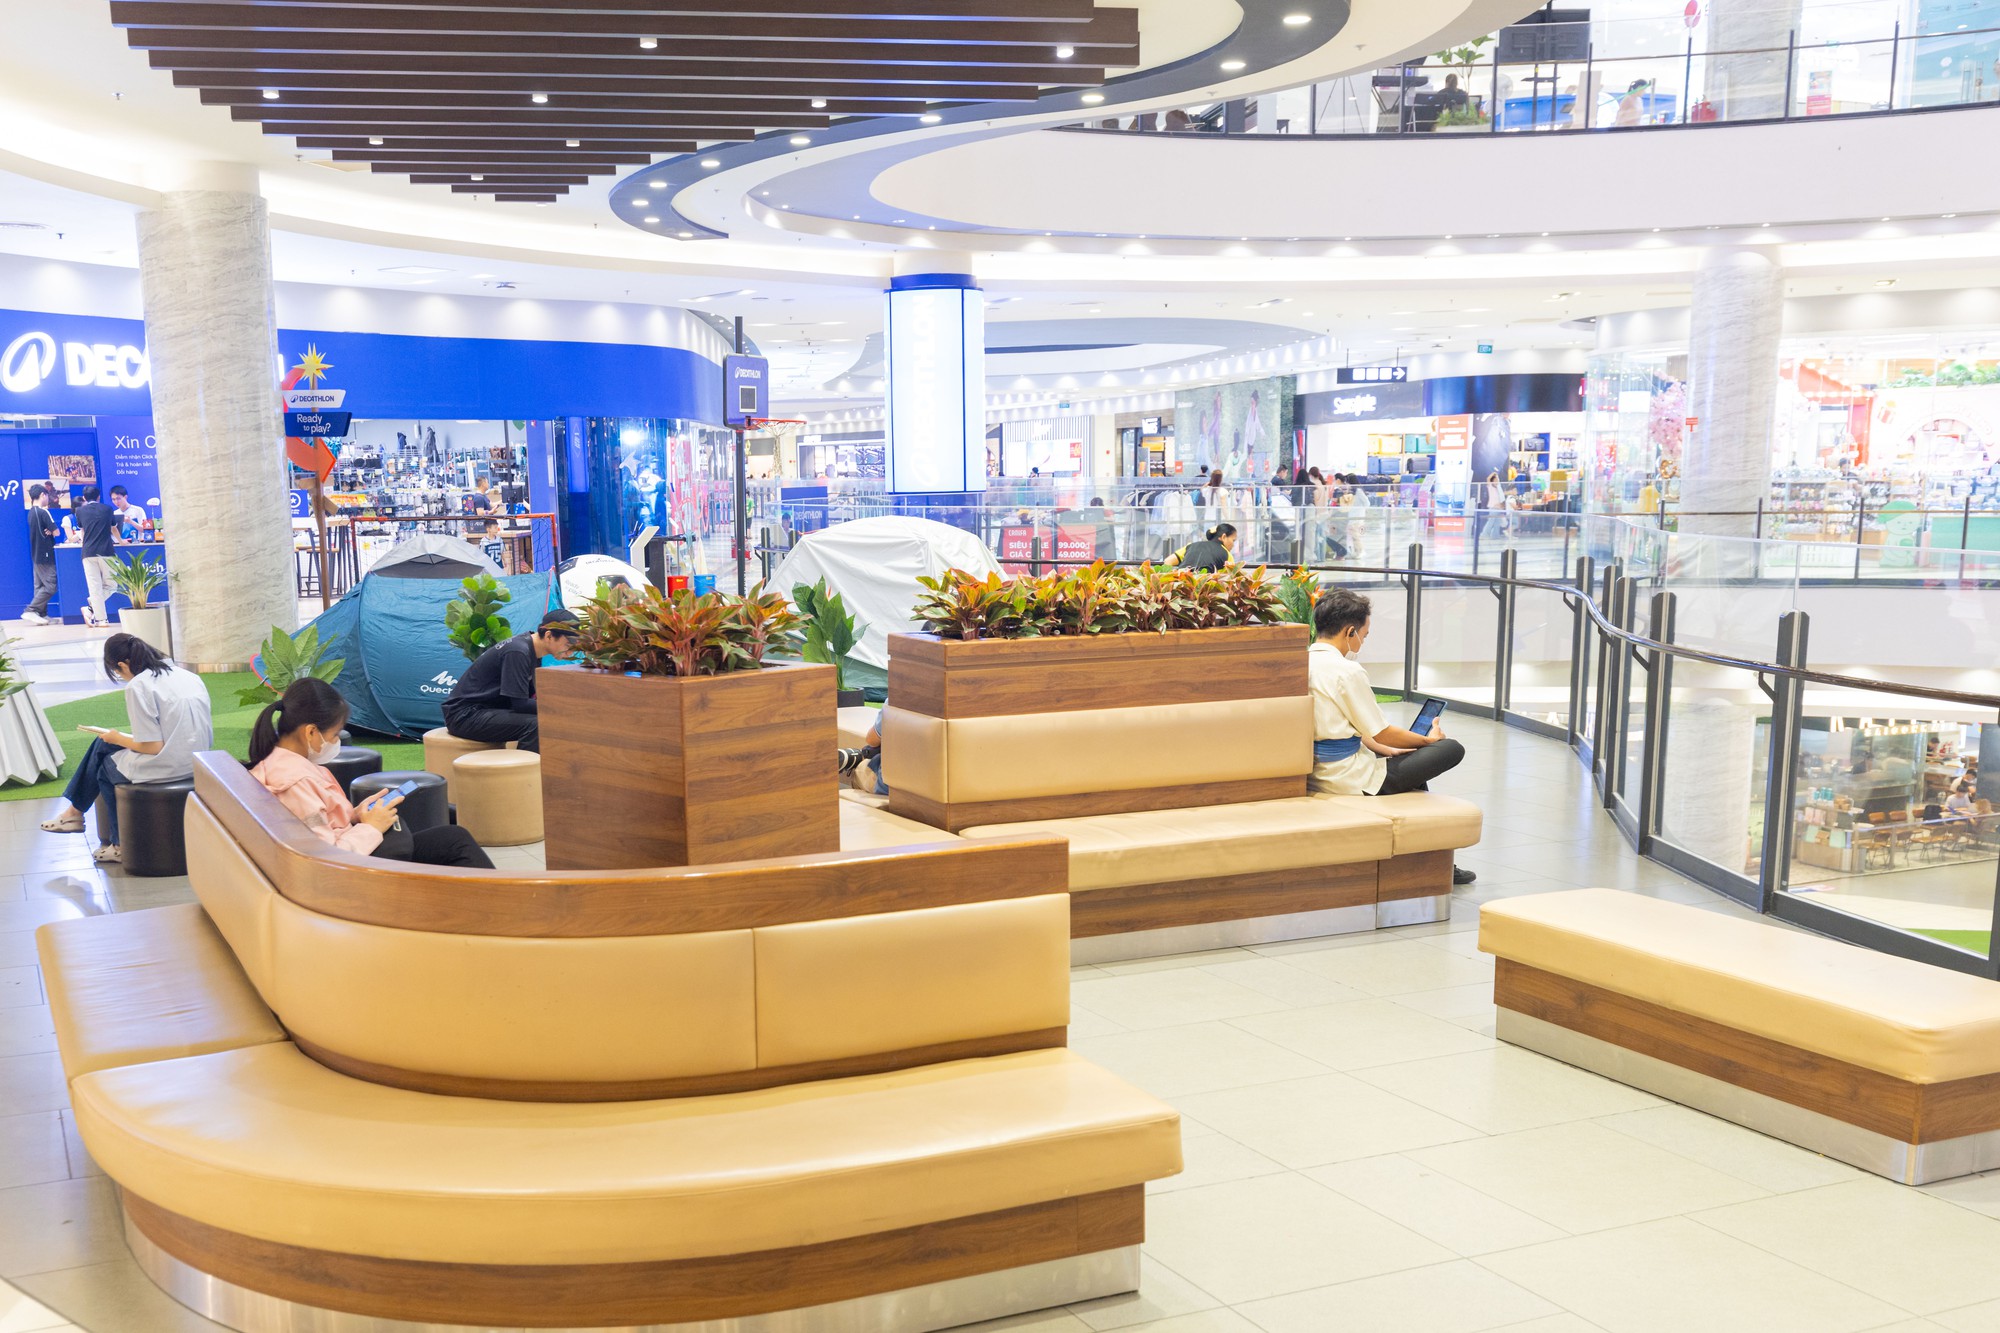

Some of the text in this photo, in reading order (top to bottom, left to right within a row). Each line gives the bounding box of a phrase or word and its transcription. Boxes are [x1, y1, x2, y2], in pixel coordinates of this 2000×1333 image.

[296, 414, 323, 424] Ready
[310, 423, 331, 435] play?
[115, 435, 140, 449] Xin
[0, 480, 19, 500] y?
[795, 510, 823, 520] DECATHLON
[1009, 540, 1028, 549] SIÊU
[1009, 550, 1024, 558] GIÁ
